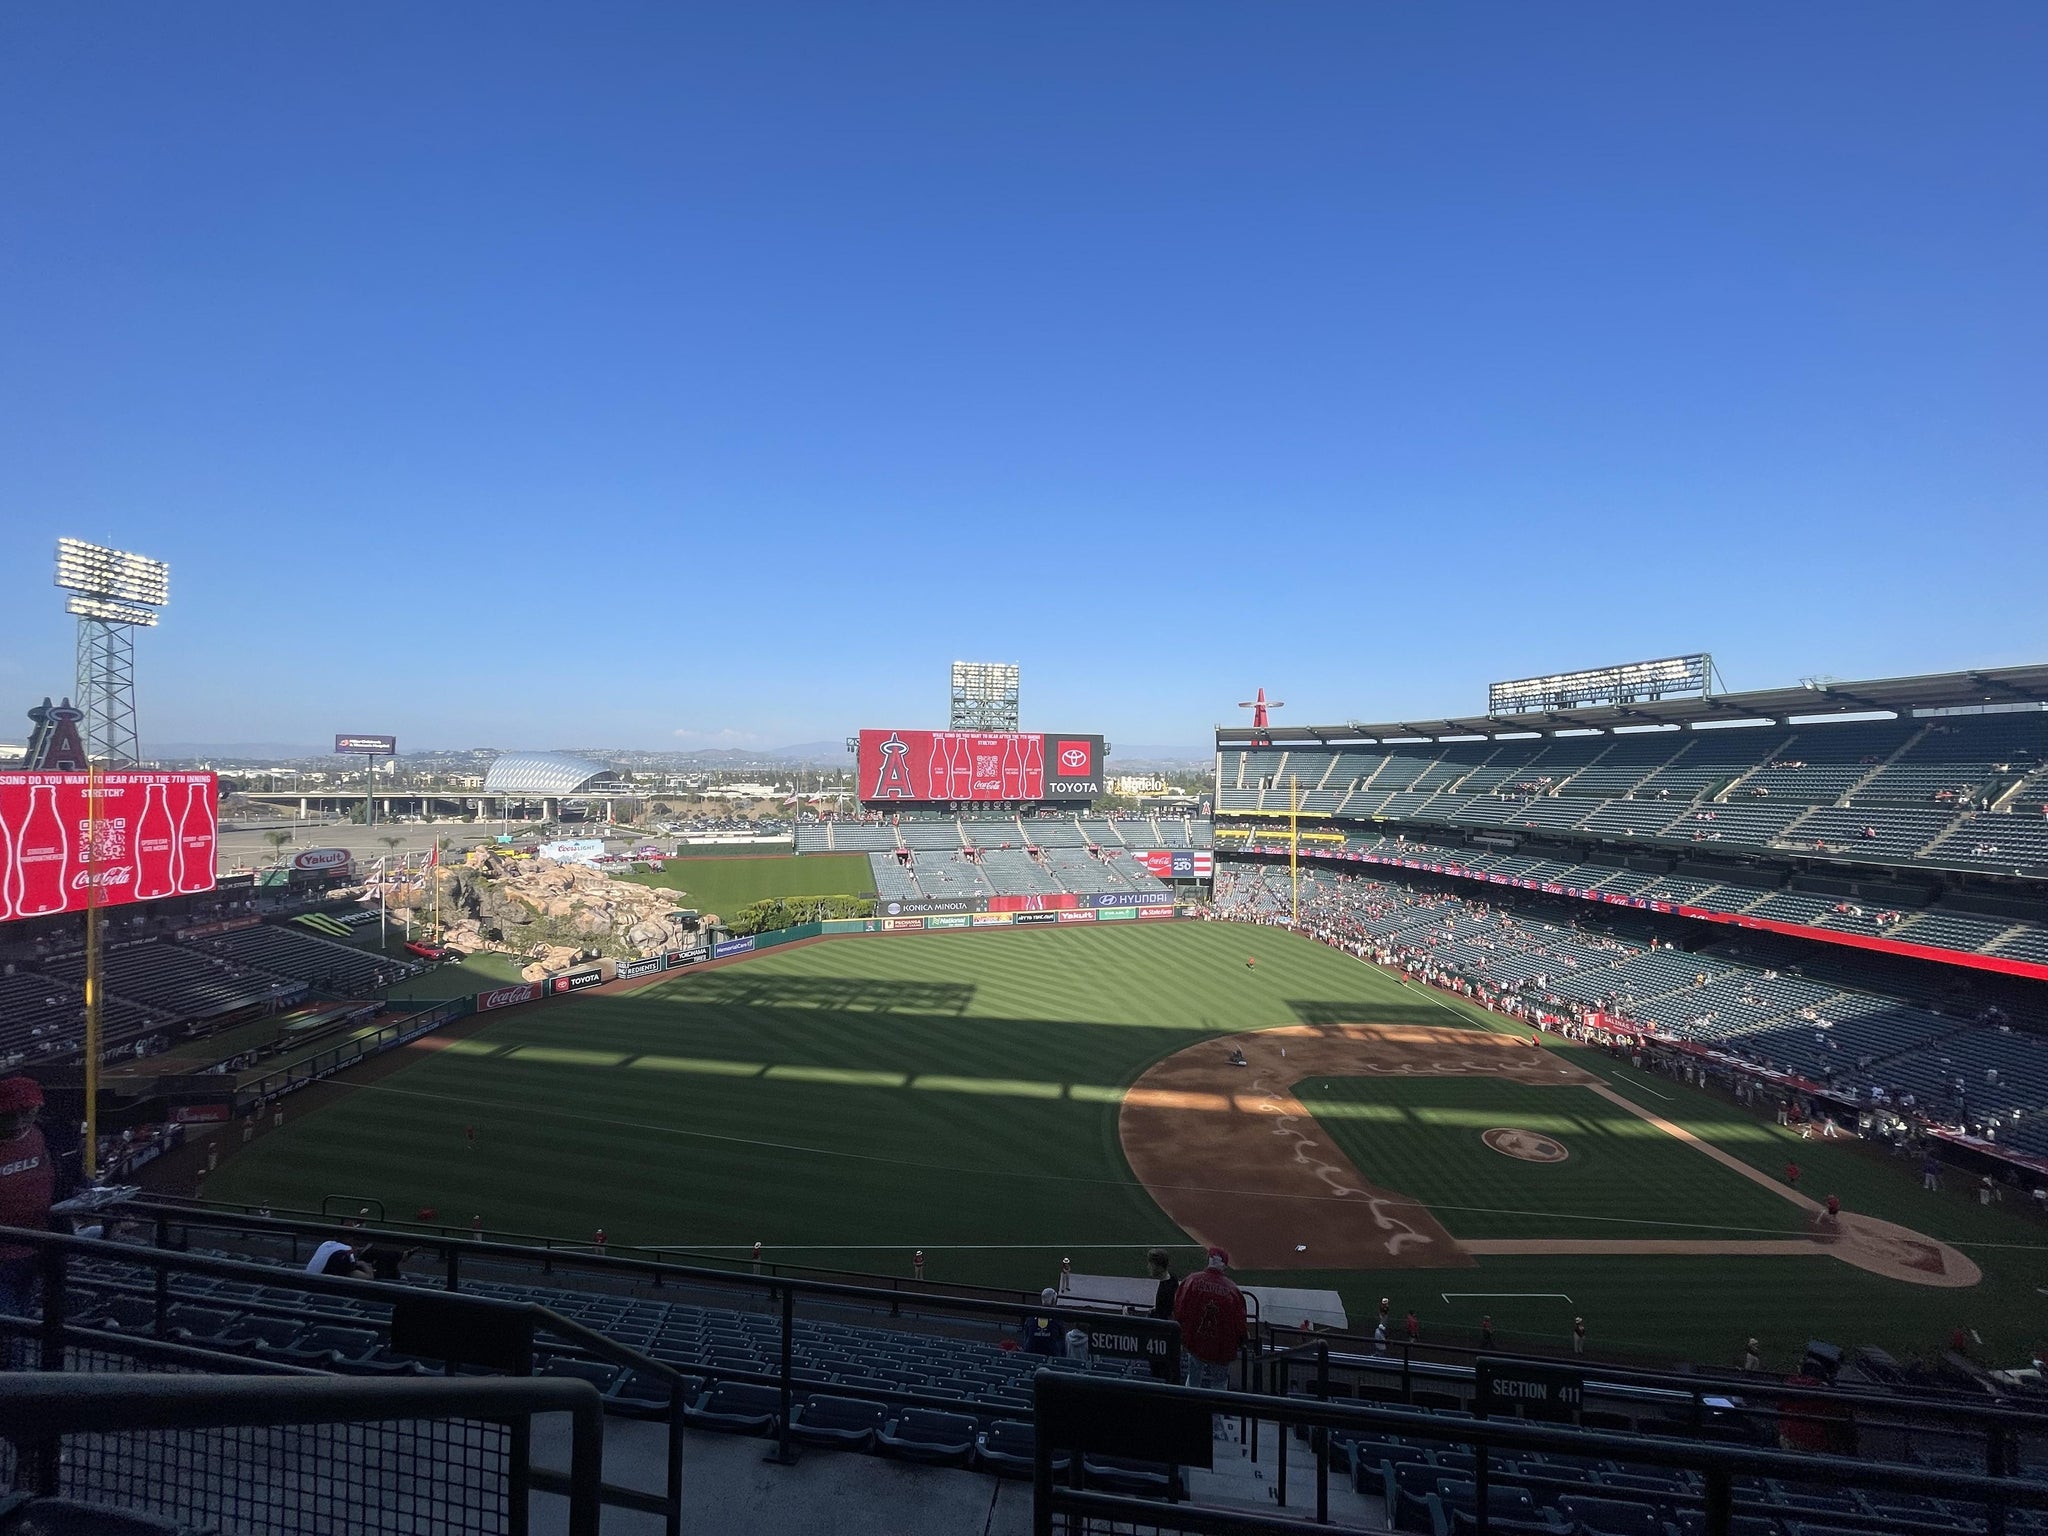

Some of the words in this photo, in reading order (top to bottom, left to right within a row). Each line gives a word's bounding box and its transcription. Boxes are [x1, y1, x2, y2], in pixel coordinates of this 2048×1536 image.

[0, 775, 26, 785] SONG
[29, 775, 42, 785] DO
[44, 775, 62, 785] YOU
[64, 775, 90, 784] WANT
[105, 775, 127, 784] HEAR
[129, 775, 154, 784] AFTER
[155, 775, 170, 783] THE
[172, 775, 186, 783] 7TH
[187, 775, 211, 783] INNING
[1121, 776, 1162, 792] Modelo
[81, 788, 125, 798] STRETCH?
[1049, 783, 1098, 793] TOYOTA
[304, 852, 342, 865] Yakult
[1173, 861, 1191, 871] 250
[1119, 893, 1167, 904] HYUNDAI
[903, 903, 933, 912] KONICA
[935, 902, 968, 911] MINOLTA
[1061, 911, 1093, 920] Yakult
[571, 974, 600, 986] TOYOTA
[486, 985, 534, 1008] Coca-Cola
[1, 1156, 40, 1176] GELS
[1091, 1332, 1138, 1353] SECTION
[1146, 1338, 1167, 1355] 410
[1493, 1378, 1547, 1399] SECTION
[1558, 1386, 1580, 1404] 411
